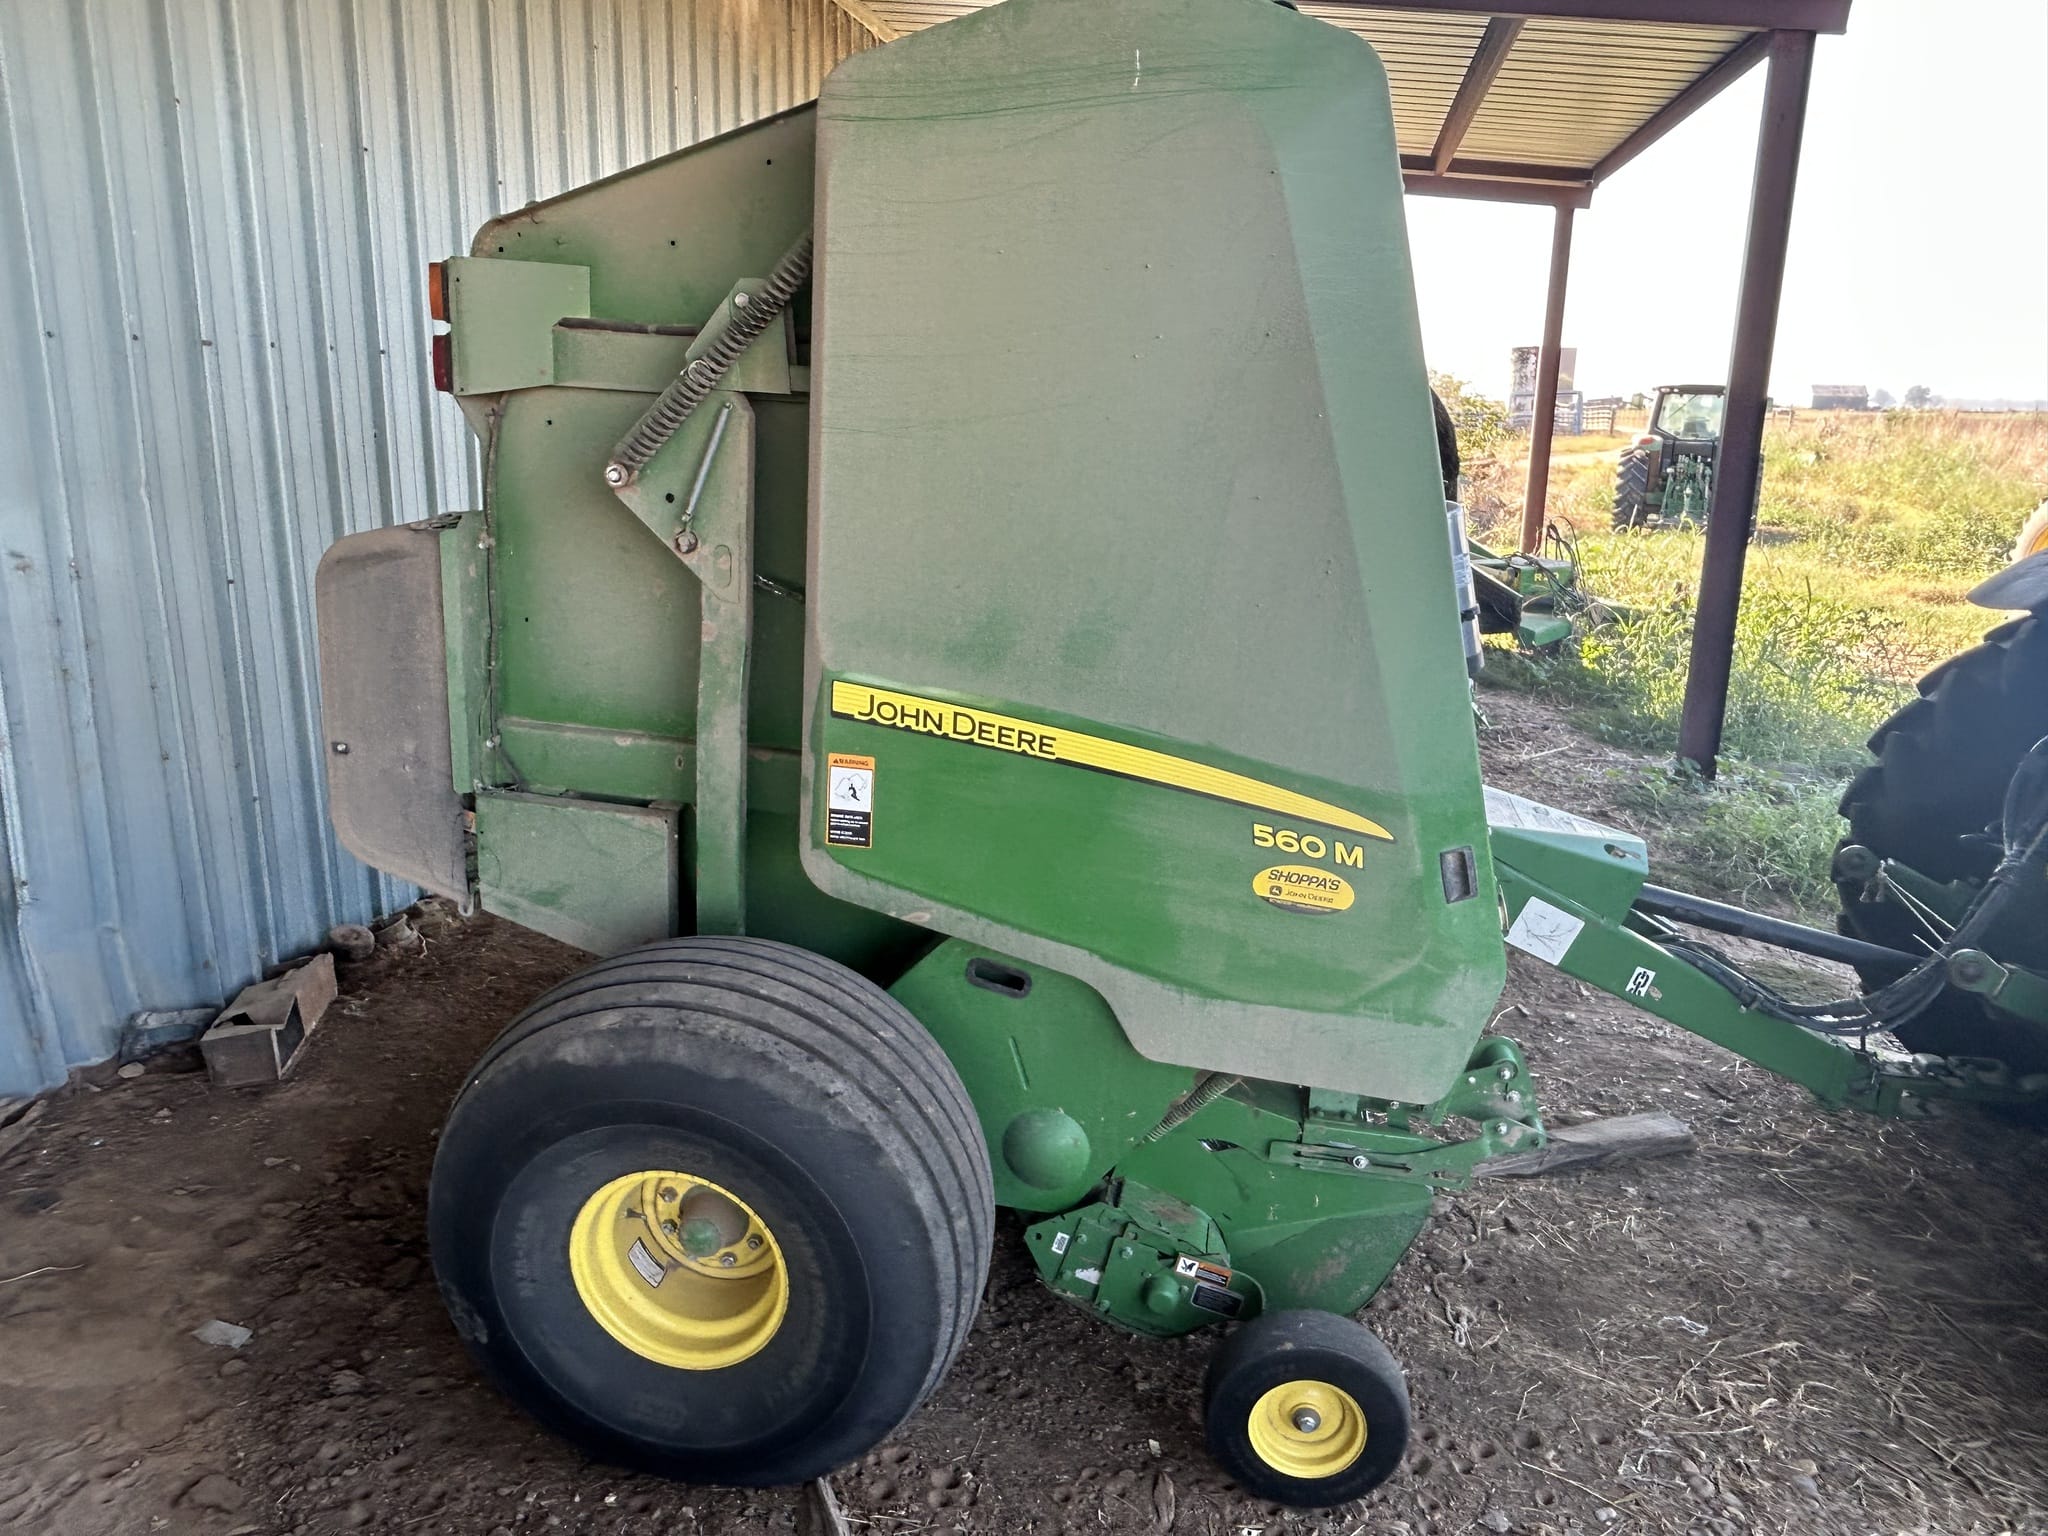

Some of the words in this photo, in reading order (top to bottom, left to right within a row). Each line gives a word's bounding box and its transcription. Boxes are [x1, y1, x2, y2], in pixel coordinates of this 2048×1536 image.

[858, 695, 943, 732] JOHN
[952, 712, 1057, 755] DEERE
[1253, 823, 1327, 858] 560
[1268, 869, 1341, 890] SHOPPA'S
